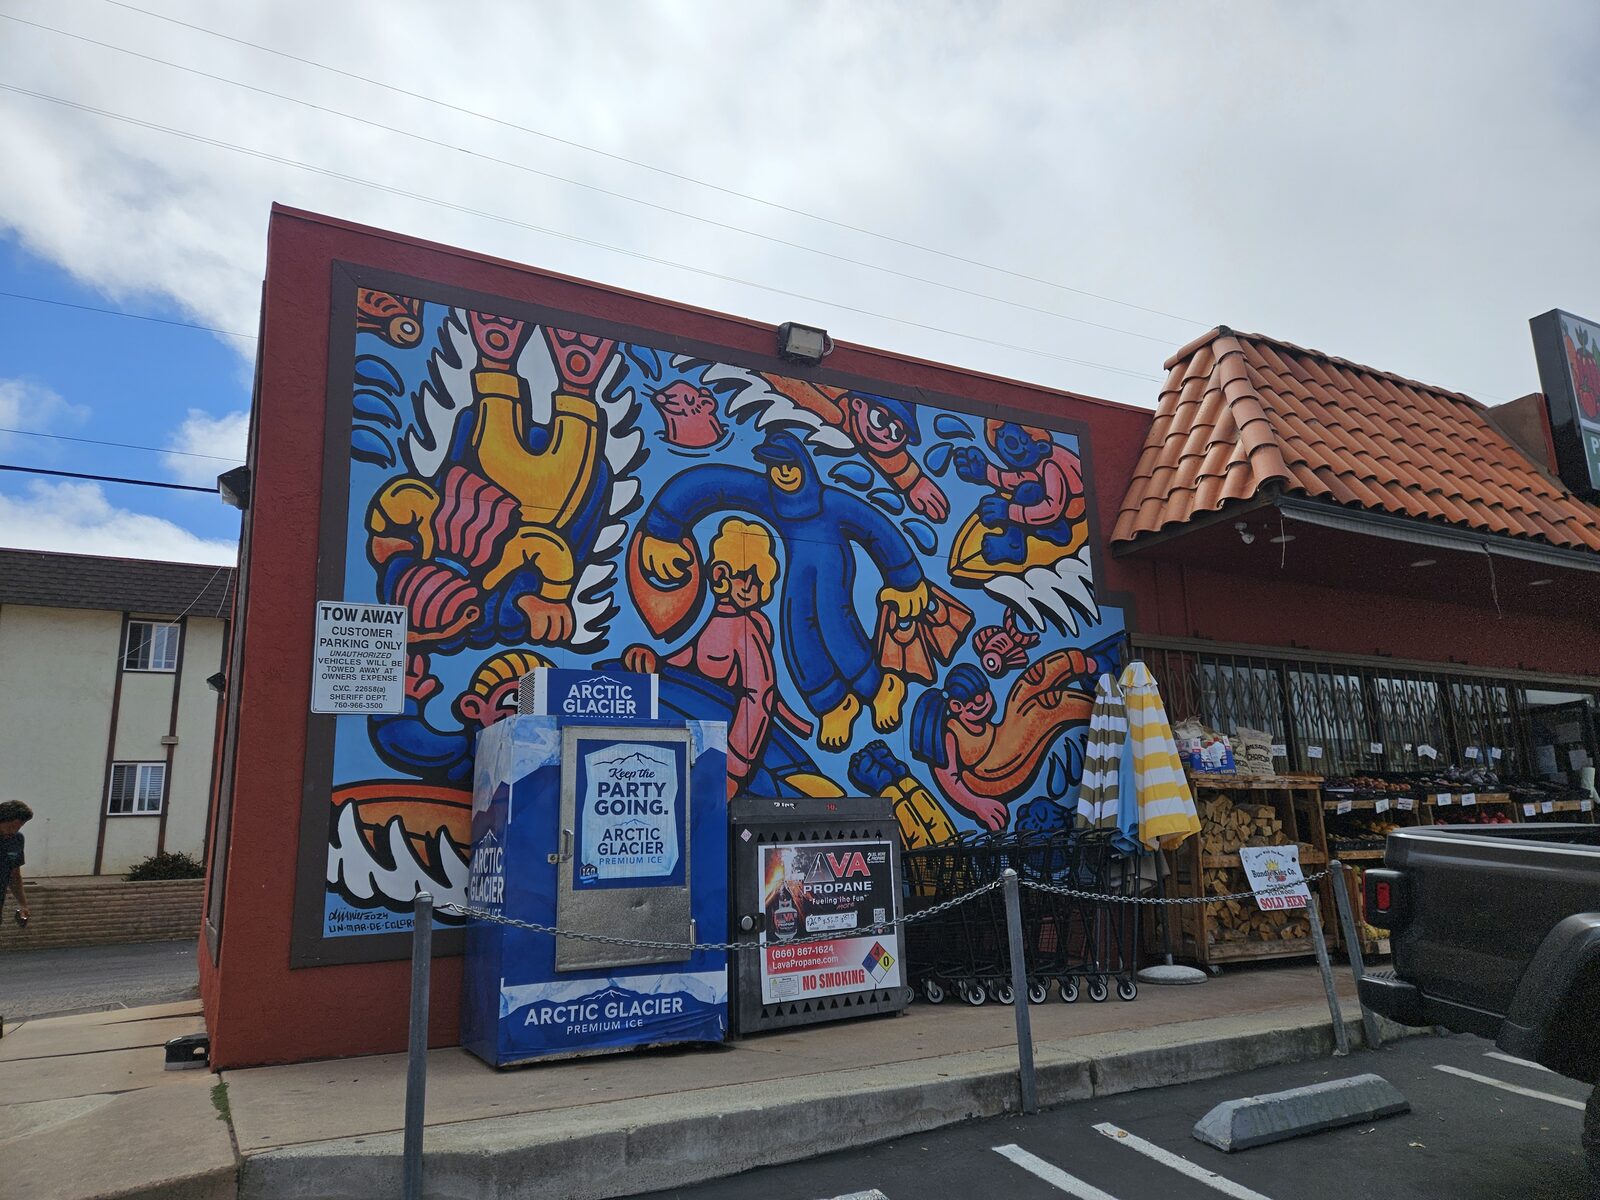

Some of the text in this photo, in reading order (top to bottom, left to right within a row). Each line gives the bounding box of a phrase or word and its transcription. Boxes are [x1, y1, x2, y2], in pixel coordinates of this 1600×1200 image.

[321, 607, 404, 624] TOW AWAY
[331, 626, 393, 638] CUSTOMER
[320, 638, 402, 650] PARKING ONLY
[329, 650, 392, 659] UNAUTHORIZED
[318, 658, 361, 666] VEHICLES
[321, 673, 357, 681] OWNERS
[567, 684, 632, 700] ARCTIC
[562, 698, 637, 715] GLACIER
[608, 767, 655, 779] Keep the
[597, 782, 667, 798] PARTY
[594, 799, 669, 816] GOING.
[602, 827, 661, 842] ARCTIC
[597, 841, 664, 856] GLACIER
[473, 847, 503, 873] ARCTIC
[599, 856, 662, 865] PREMIUM ICE
[470, 876, 504, 903] GLACIER
[803, 881, 872, 895] PROPANE
[1260, 896, 1285, 909] SOLD
[364, 912, 389, 920] 2024
[329, 924, 344, 933] UN
[345, 923, 367, 932] MAR
[369, 922, 382, 931] DE
[772, 944, 834, 960] (866) 867-1624
[772, 956, 839, 970] LavaPropane.com
[883, 956, 889, 967] 0
[802, 974, 817, 991] NO
[819, 969, 865, 990] SMOKING
[524, 997, 683, 1026] ARCTIC GLACIER
[566, 1019, 644, 1035] PREMIUM ICE
